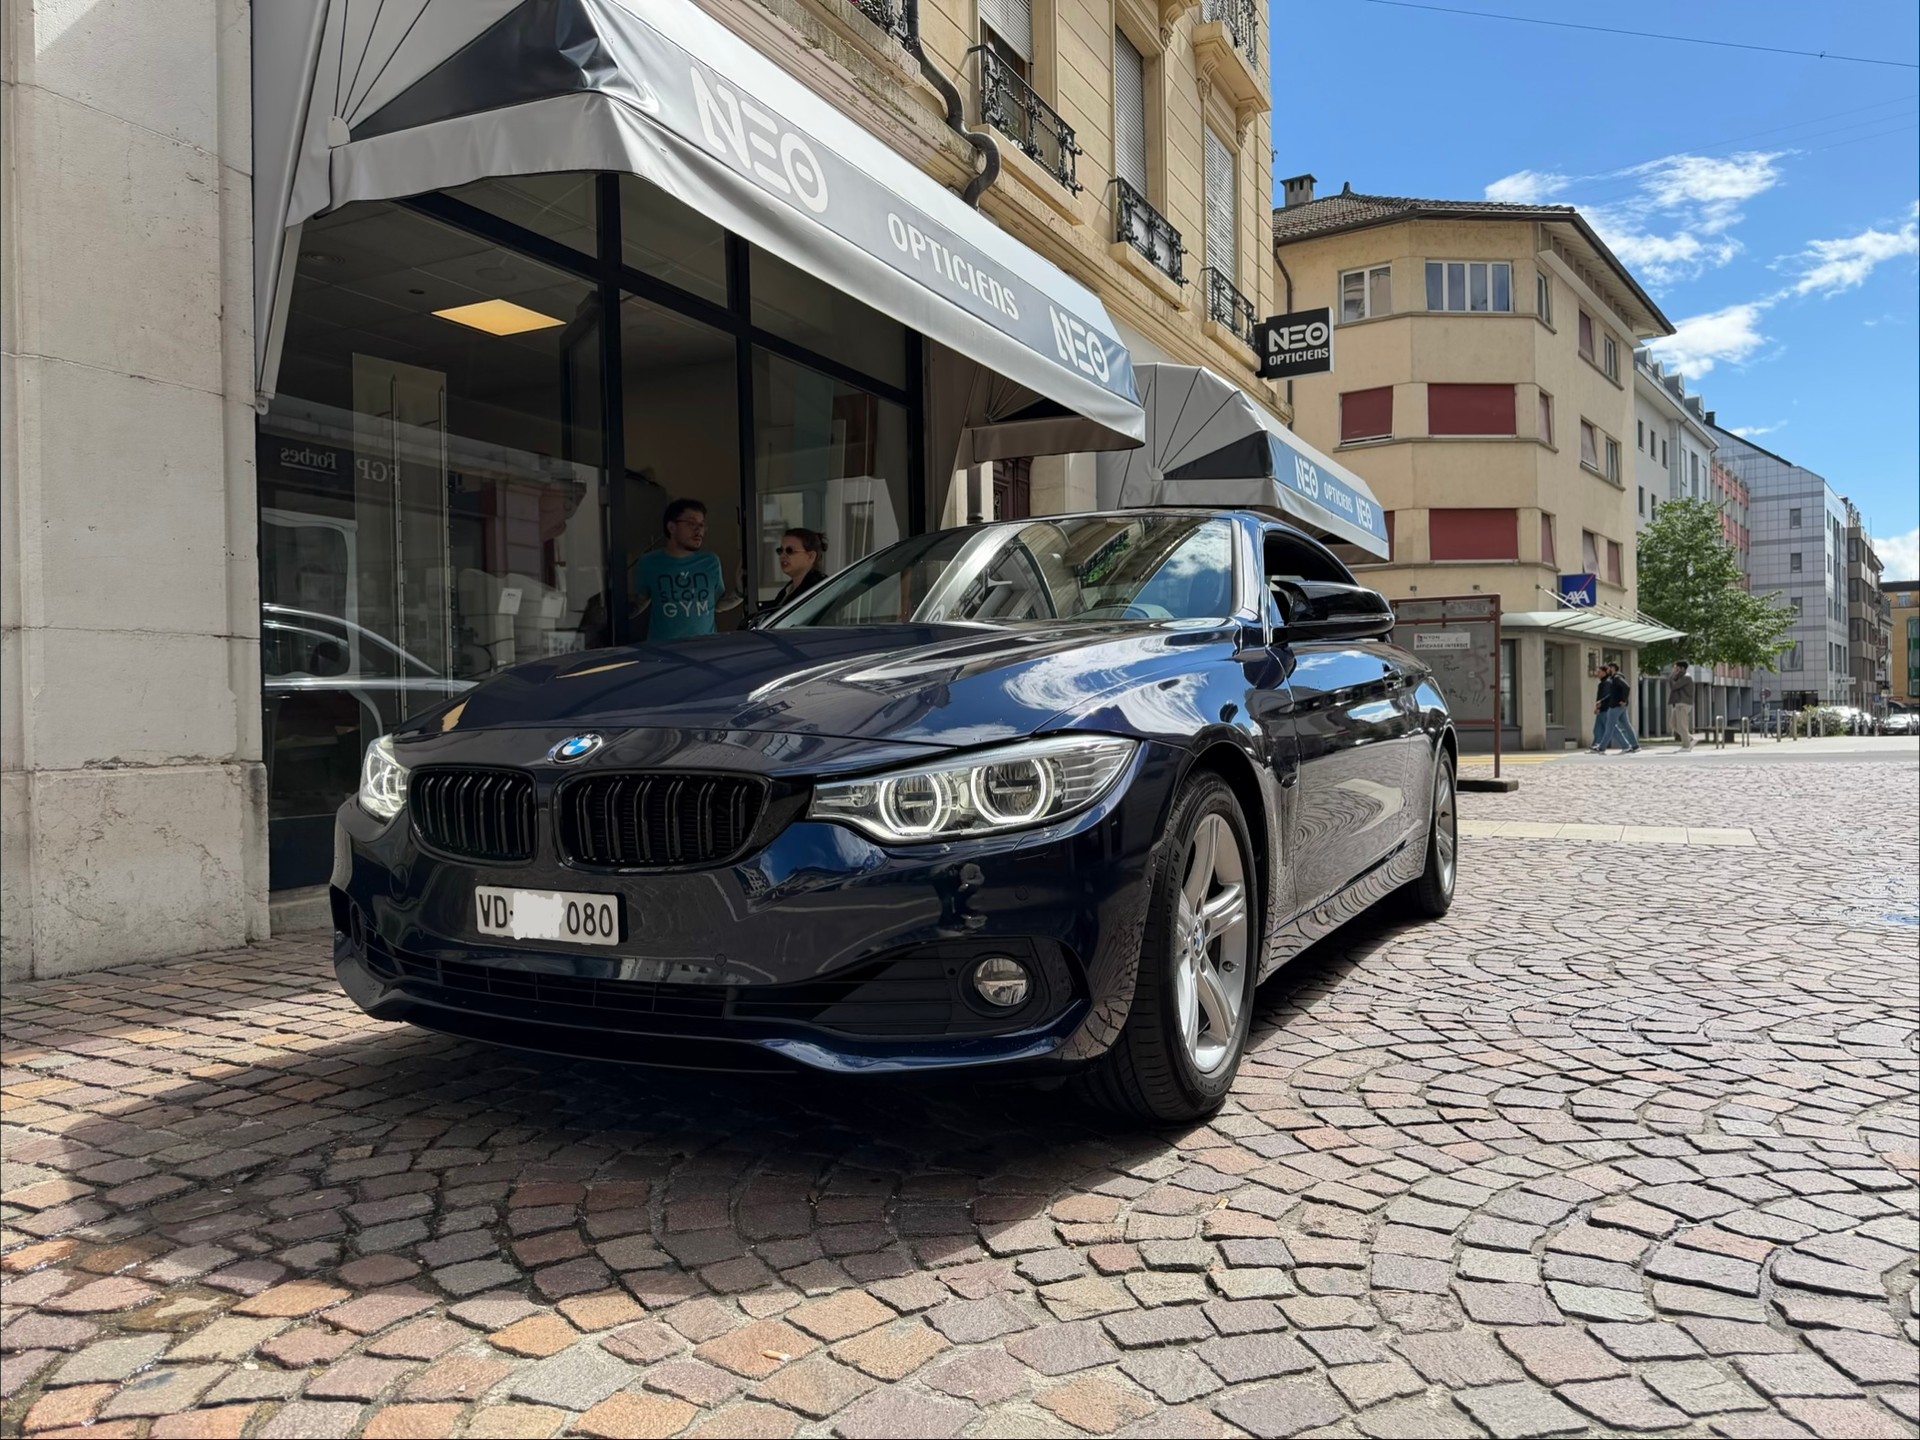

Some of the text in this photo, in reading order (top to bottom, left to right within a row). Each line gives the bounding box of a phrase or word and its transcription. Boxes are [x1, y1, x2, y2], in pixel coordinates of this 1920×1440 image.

[690, 66, 828, 213] NEO
[1050, 304, 1110, 383] NEO
[1268, 322, 1329, 353] NEO
[1294, 455, 1319, 500] NEO
[1355, 495, 1373, 531] NEO
[663, 600, 710, 618] GYM
[1562, 590, 1591, 605] AXA
[566, 901, 613, 938] 080
